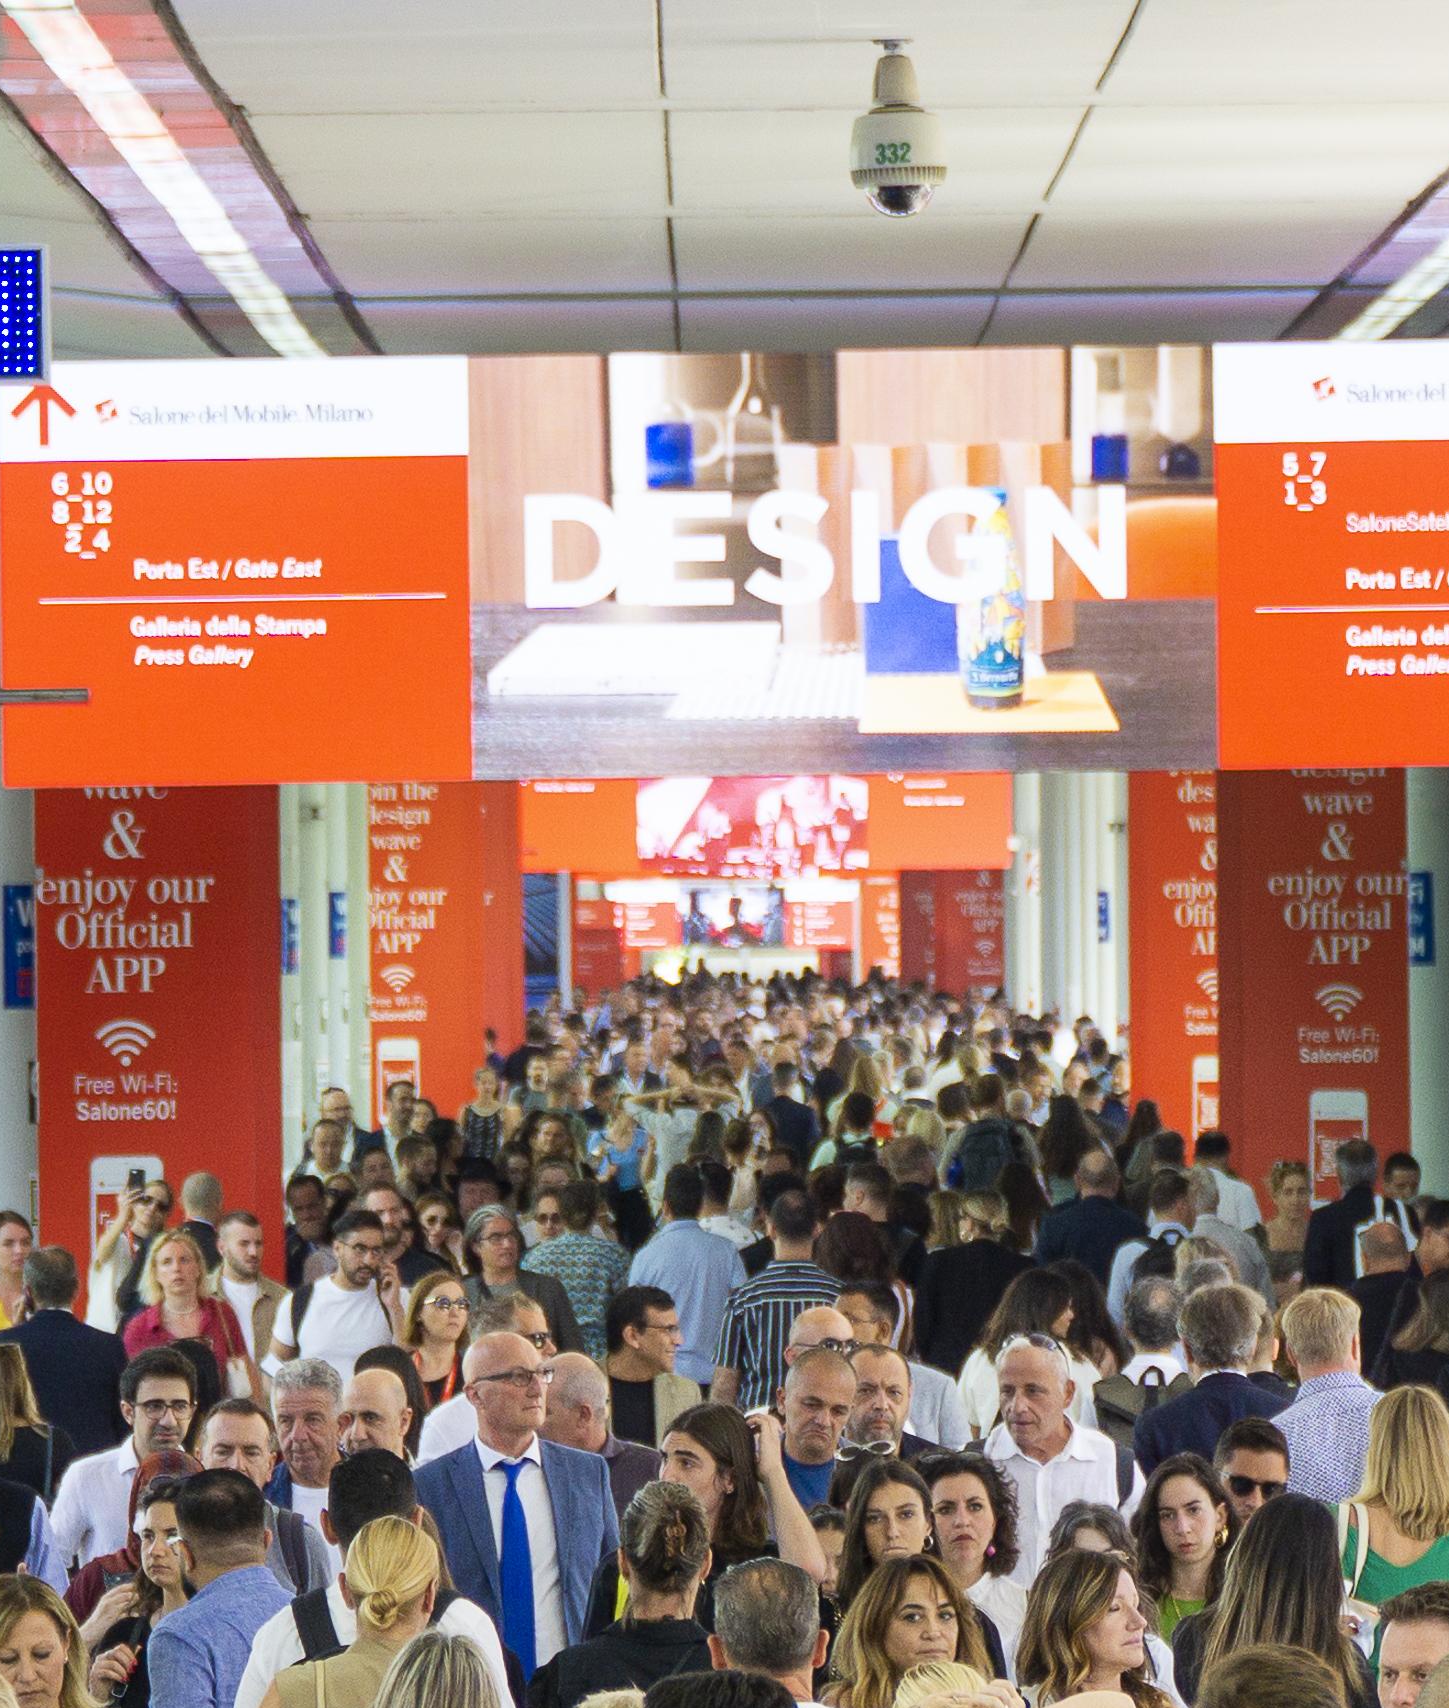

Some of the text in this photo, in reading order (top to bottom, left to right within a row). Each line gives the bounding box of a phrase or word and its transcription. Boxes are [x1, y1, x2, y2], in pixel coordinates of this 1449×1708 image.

[875, 142, 912, 165] 332
[1346, 384, 1411, 404] Salone
[1416, 382, 1445, 402] del
[129, 406, 195, 426] Salone
[199, 404, 229, 424] del
[306, 402, 373, 422] Milano
[524, 485, 1127, 609] DESIGN
[134, 559, 183, 580] Porta
[188, 557, 218, 580] Est
[235, 558, 277, 579] Gate
[282, 558, 322, 579] East
[1346, 568, 1395, 590] Porta
[1401, 568, 1430, 589] Est
[130, 615, 326, 638] Galleria della Stampa
[1346, 626, 1417, 647] Galleria
[134, 645, 253, 668] Press Gallery
[1346, 656, 1395, 676] Press
[1303, 792, 1373, 815] wave
[103, 809, 146, 860] &
[371, 834, 422, 851] wave
[1320, 822, 1353, 862] &
[383, 854, 408, 883] &
[37, 868, 214, 914] enjoy our
[1268, 866, 1408, 901] enjoy our
[408, 890, 447, 906] our
[1283, 901, 1392, 931] Official
[55, 910, 194, 950] Official
[376, 932, 422, 954] APP
[1308, 936, 1371, 965] APP
[85, 957, 166, 994] APP
[1298, 1025, 1380, 1044] Free Wi-Fi:
[1299, 1047, 1379, 1064] Salone60!
[74, 1073, 179, 1095] Free Wi-Fi:
[76, 1101, 177, 1121] Salone60!
